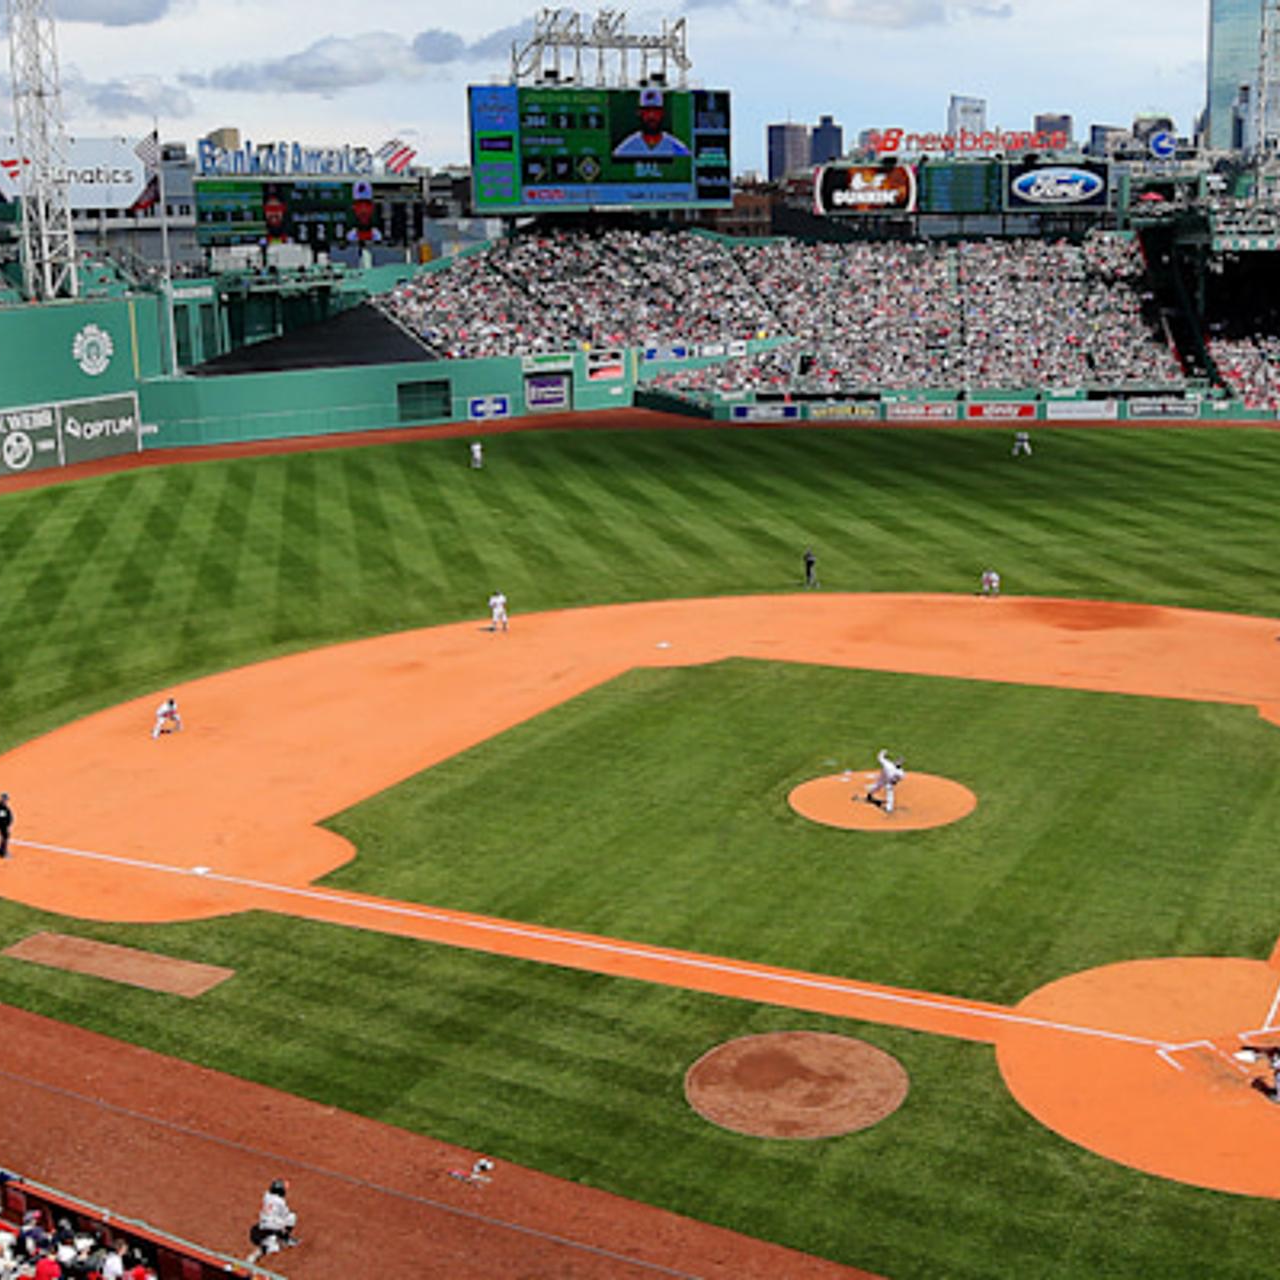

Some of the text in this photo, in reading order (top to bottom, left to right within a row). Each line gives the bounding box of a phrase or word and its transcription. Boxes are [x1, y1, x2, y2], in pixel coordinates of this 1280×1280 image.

[906, 133, 955, 151] new
[960, 128, 1067, 150] balance
[198, 139, 260, 175] Bank
[291, 141, 372, 174] America
[1029, 175, 1085, 198] Ford
[83, 416, 133, 440] OPTUM
